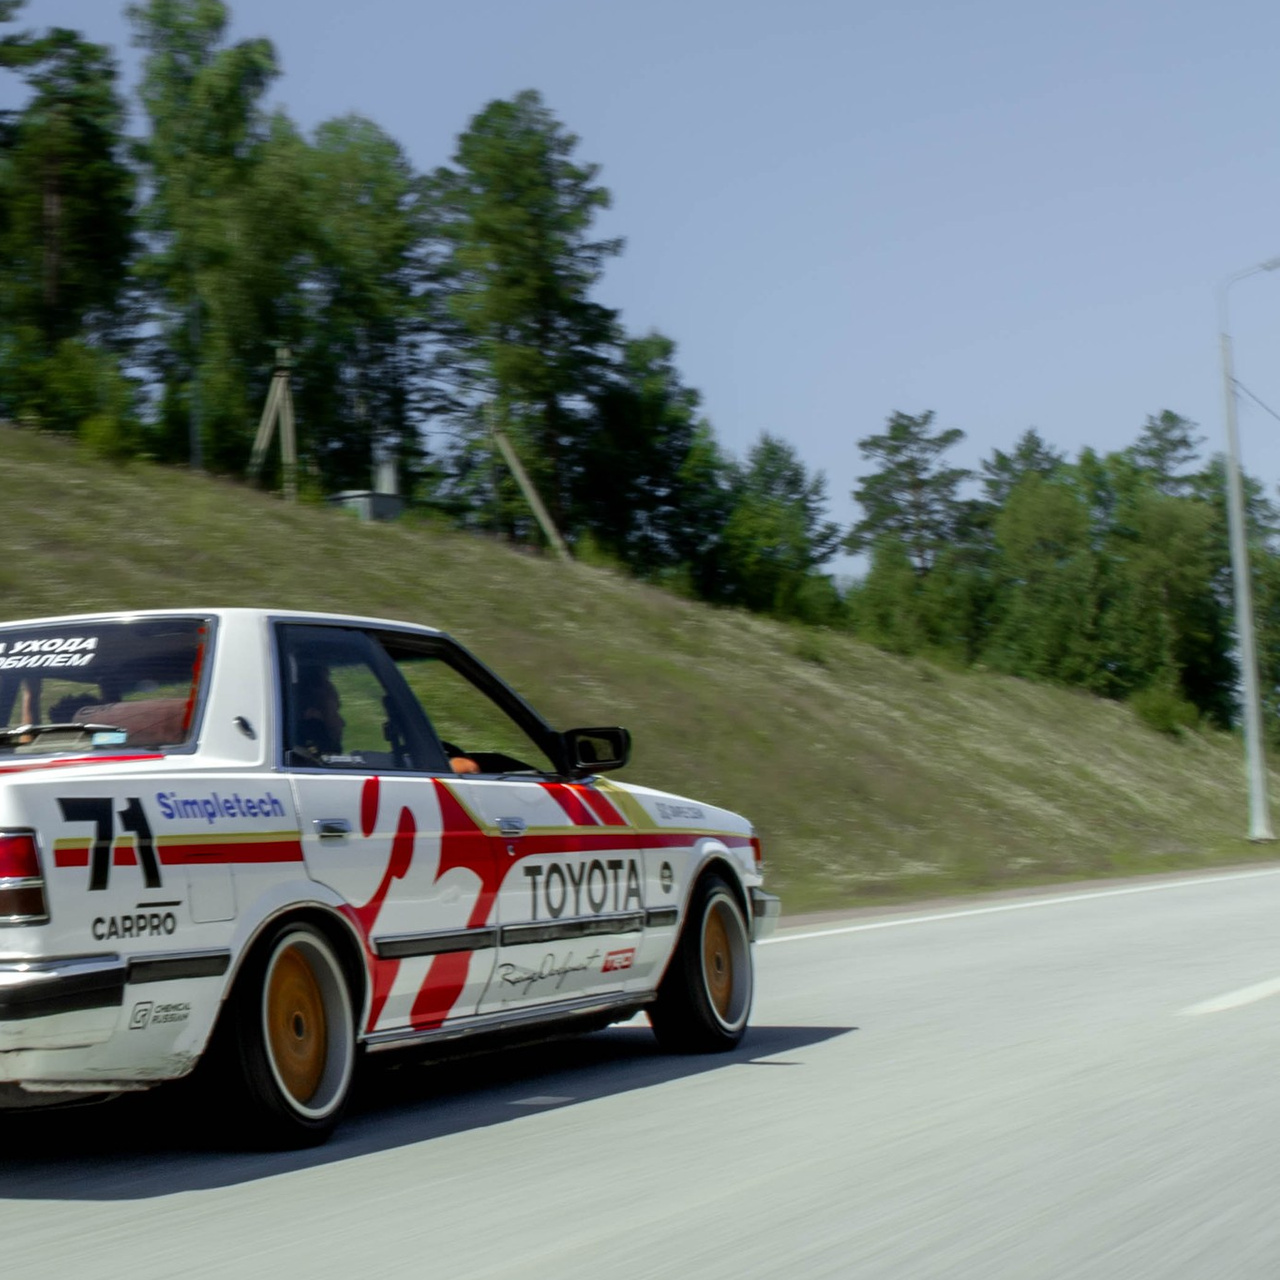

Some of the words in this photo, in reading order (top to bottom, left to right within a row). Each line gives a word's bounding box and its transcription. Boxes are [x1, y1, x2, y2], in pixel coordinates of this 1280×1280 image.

[7, 636, 98, 655] УХОДА
[156, 792, 287, 824] Simpletech
[57, 797, 163, 891] 71
[523, 858, 643, 920] TOYOTA
[92, 912, 177, 941] CARPRO
